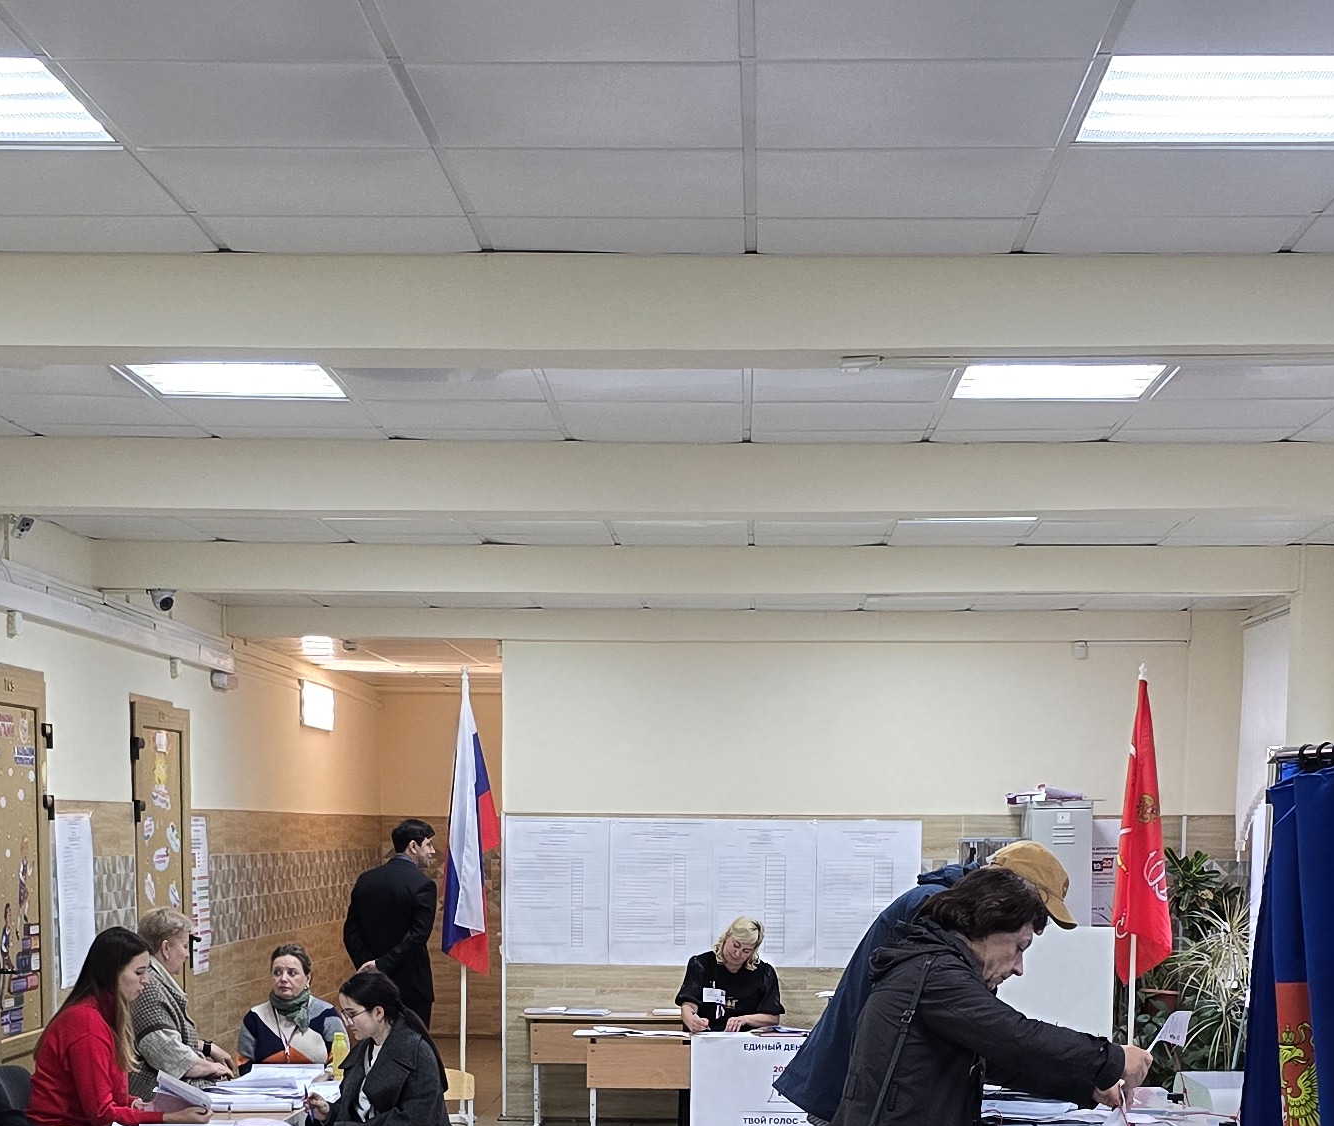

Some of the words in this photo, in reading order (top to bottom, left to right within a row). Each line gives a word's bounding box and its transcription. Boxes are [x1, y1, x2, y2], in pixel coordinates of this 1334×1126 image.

[743, 1042, 782, 1051] ЕДИНЫЙ
[783, 1043, 802, 1051] ДЕН
[743, 1116, 767, 1125] ТВОЙ
[768, 1117, 799, 1125] ГОЛОС
